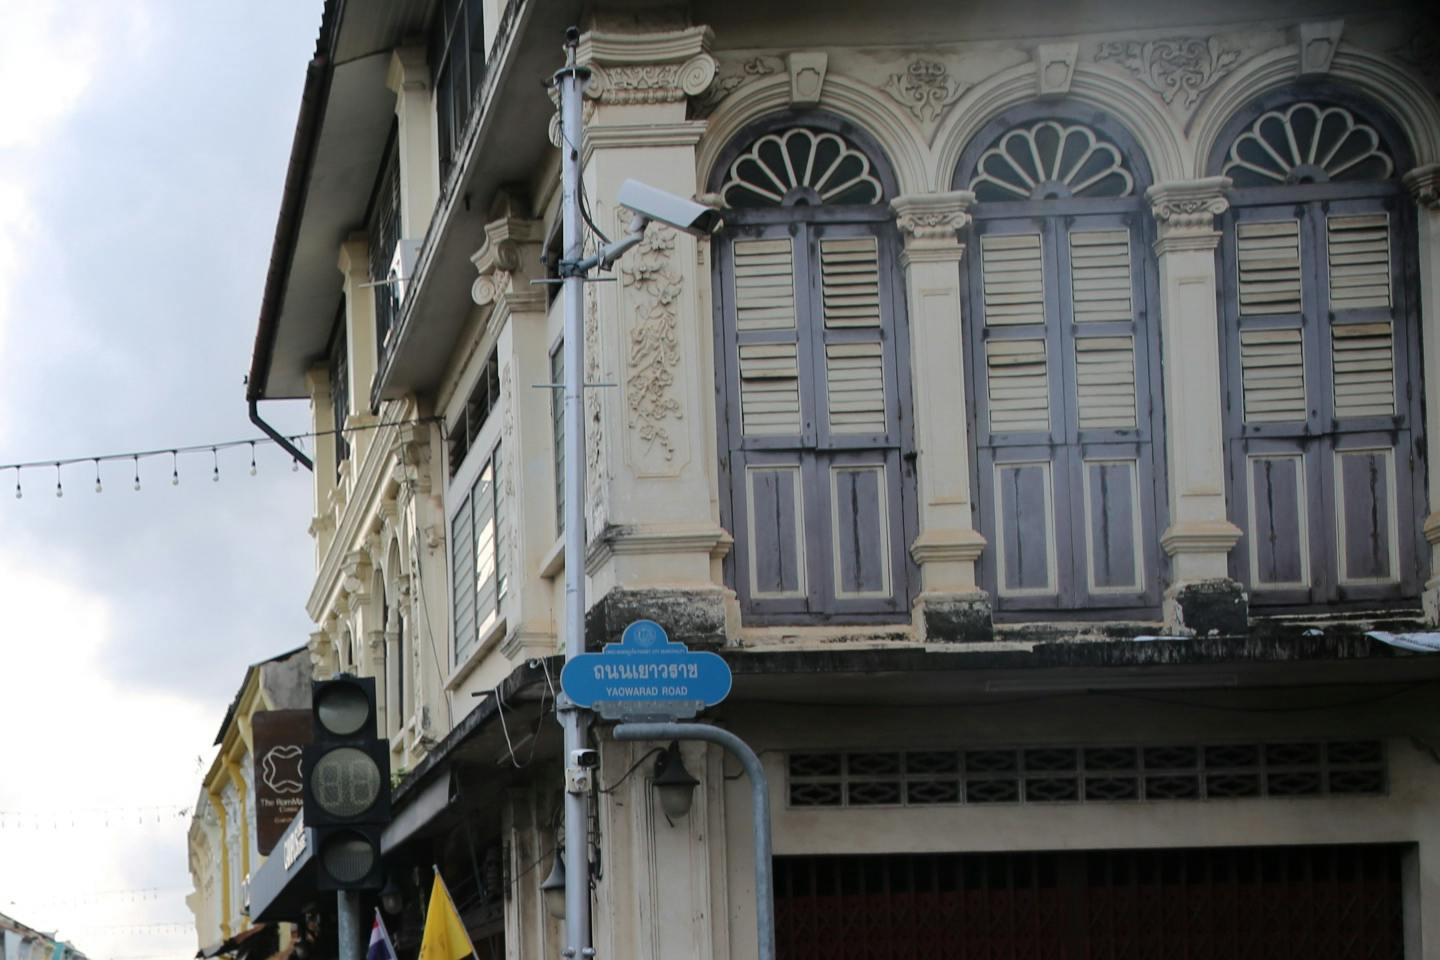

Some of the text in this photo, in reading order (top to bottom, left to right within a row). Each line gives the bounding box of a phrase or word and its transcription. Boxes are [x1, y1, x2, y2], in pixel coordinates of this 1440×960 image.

[593, 663, 698, 680] ถนนเยาวราช
[606, 687, 688, 696] YAOWARAD ROAD
